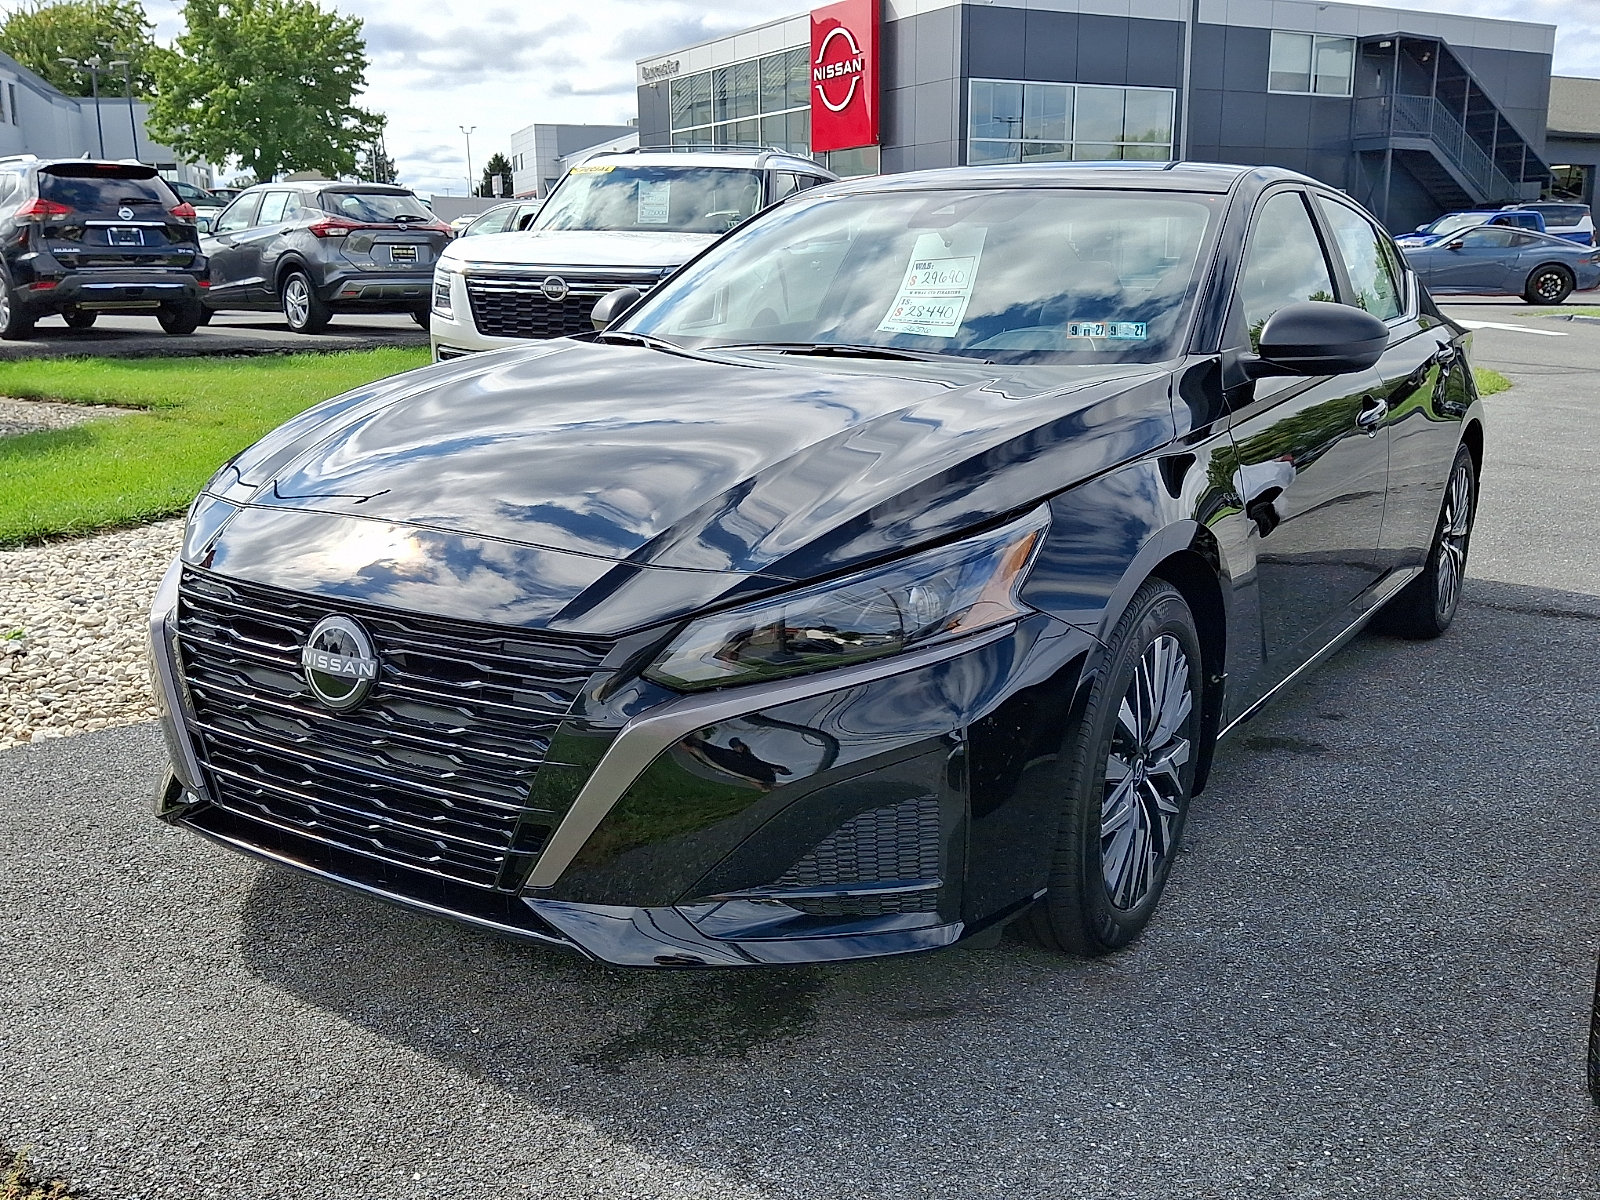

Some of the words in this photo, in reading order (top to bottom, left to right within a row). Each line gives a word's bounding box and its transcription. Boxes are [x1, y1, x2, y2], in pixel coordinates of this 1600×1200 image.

[813, 57, 862, 81] NISSAN
[915, 262, 935, 270] WAS:
[921, 270, 964, 285] 29690
[905, 306, 953, 318] 28440
[1071, 325, 1078, 335] 9
[1095, 324, 1105, 335] 27
[1110, 325, 1117, 335] 9
[1134, 325, 1144, 336] 27
[302, 649, 374, 677] NISSAN
